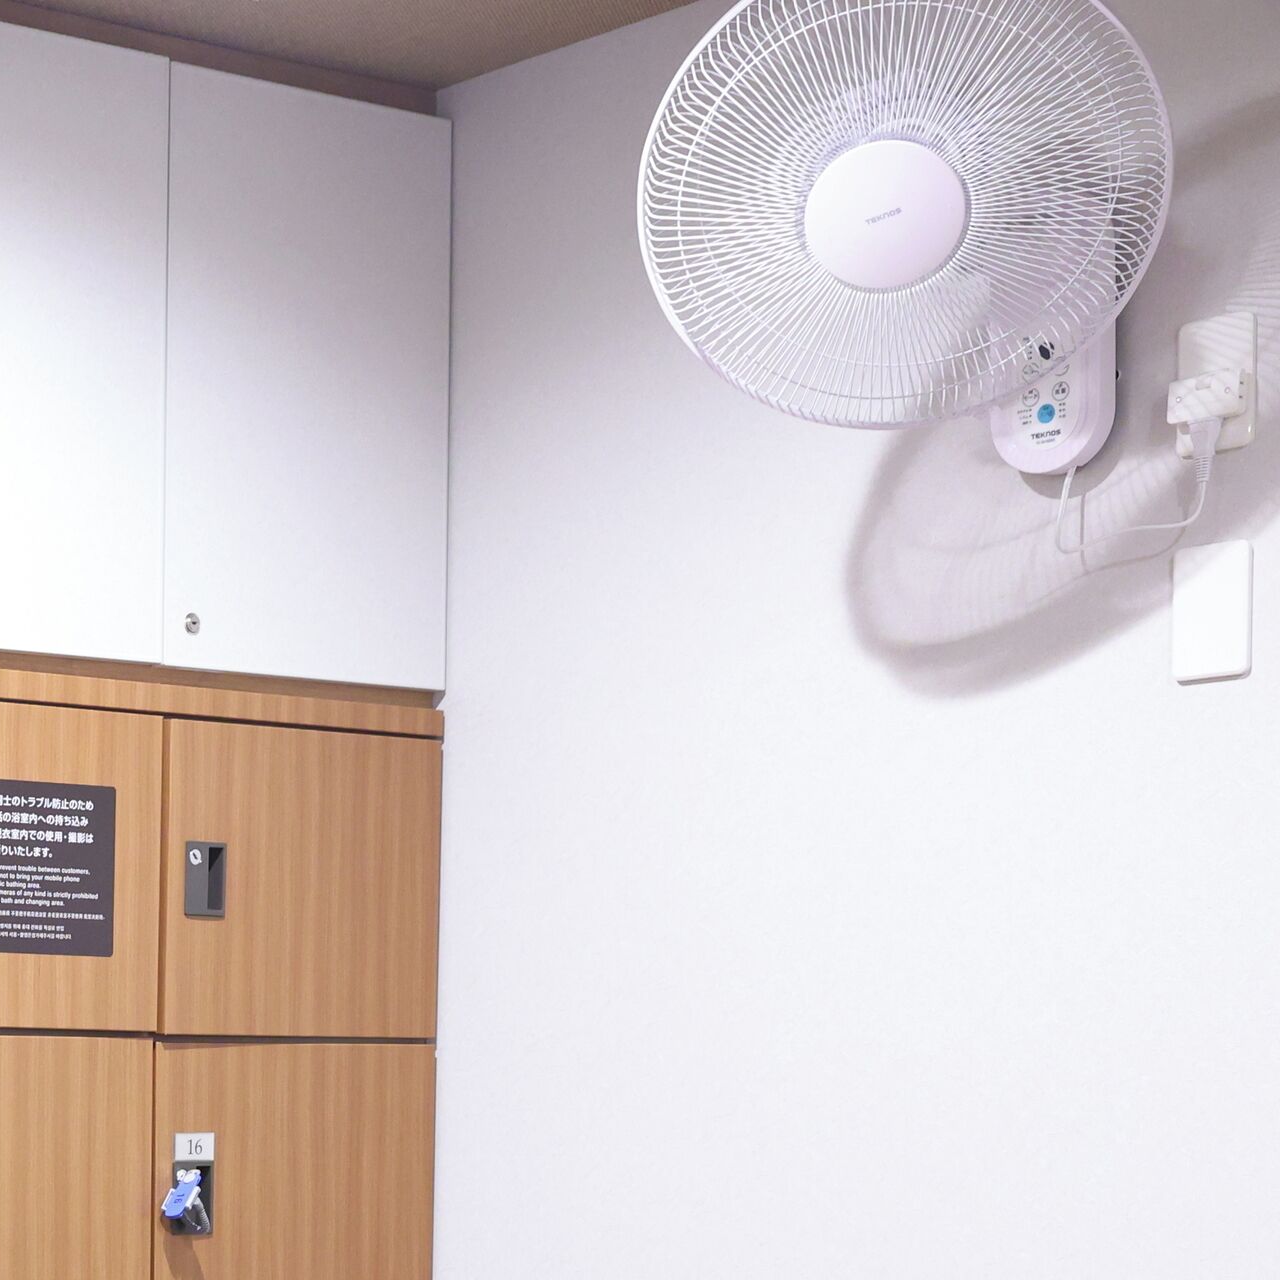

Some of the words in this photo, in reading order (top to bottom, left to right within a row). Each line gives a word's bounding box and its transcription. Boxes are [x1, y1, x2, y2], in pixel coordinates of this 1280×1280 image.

[864, 207, 902, 224] TEKNOS
[1031, 429, 1061, 440] TEKNOS
[188, 1139, 203, 1155] 16
